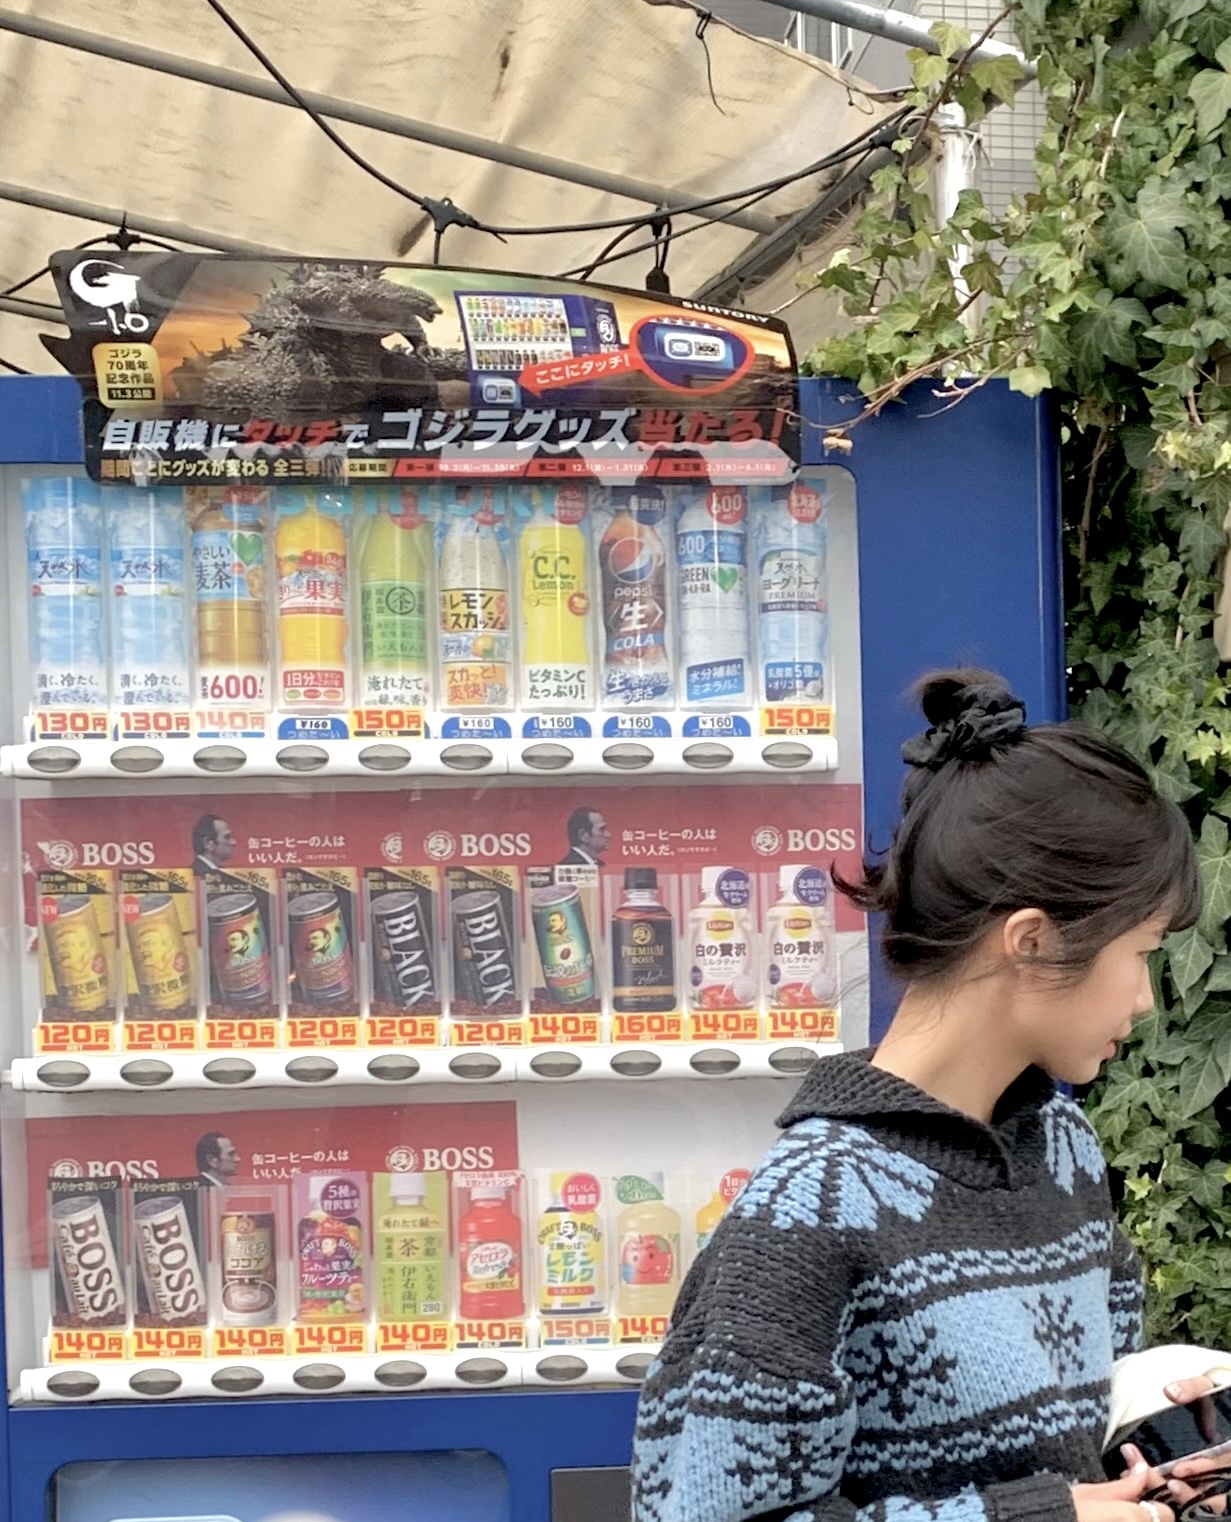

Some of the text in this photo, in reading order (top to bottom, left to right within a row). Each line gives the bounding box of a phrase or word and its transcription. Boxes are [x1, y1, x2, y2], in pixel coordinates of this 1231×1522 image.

[108, 348, 142, 360] ゴジラ
[107, 360, 149, 372] 70周年
[535, 353, 631, 386] ここにタッチ!
[106, 372, 155, 386] 記念作品
[192, 545, 231, 560] やさしい
[37, 559, 91, 580] 天然水
[120, 559, 173, 580] 天然水
[195, 563, 232, 591] 麦茶
[532, 555, 577, 580] C.C.
[531, 579, 575, 591] Lemon
[450, 592, 495, 610] レモン
[619, 600, 649, 633] 生
[613, 632, 656, 651] COLA
[528, 669, 587, 684] ビタミンC
[528, 684, 586, 700] たっぷり!
[37, 711, 107, 732] 130円
[120, 711, 190, 732] 130円
[195, 710, 266, 731] 140円
[300, 720, 329, 730] ¥160
[352, 710, 422, 729] 150円
[462, 717, 492, 728] ¥160
[541, 716, 574, 729] ¥160
[620, 716, 652, 729] ¥160
[700, 716, 732, 729] ¥160
[764, 708, 831, 728] 150円
[247, 835, 346, 849] 缶コーヒーの人は
[460, 832, 532, 857] BOSS
[621, 828, 717, 842] 缶コーヒーの人は
[786, 828, 856, 852] BOSS
[81, 841, 156, 866] BOSS
[707, 921, 732, 930] Lipton
[785, 919, 810, 928] Lipton
[621, 945, 664, 957] PREMIUM
[695, 942, 747, 957] 白の贅沢
[773, 940, 825, 956] 白の贅沢
[383, 911, 434, 1010] BLACK
[464, 910, 515, 1009] BLACK
[288, 1019, 357, 1039] 120円
[366, 1018, 435, 1038] 120円
[529, 1015, 597, 1035] 140円
[615, 1014, 682, 1033] 160円
[691, 1013, 759, 1032] 140円
[768, 1011, 836, 1031] 140円
[40, 1024, 110, 1044] 120円
[124, 1022, 194, 1043] 120円
[205, 1021, 275, 1041] 120円
[453, 1023, 522, 1042] 120円
[252, 1149, 349, 1166] 缶コーヒーの人は
[422, 1146, 495, 1170] BOSS
[86, 1160, 160, 1179] BOSS
[566, 1183, 597, 1193] おいしく
[399, 1238, 420, 1258] 茶
[70, 1214, 118, 1313] BOSS
[152, 1214, 200, 1313] BOSS
[230, 1257, 264, 1270] ココア
[546, 1251, 595, 1268] レモン
[301, 1271, 359, 1286] フルーツティー
[546, 1268, 594, 1284] ミルク
[400, 1265, 418, 1315] 伊右衛門
[294, 1326, 363, 1345] 140円
[379, 1324, 447, 1343] 140円
[455, 1322, 523, 1341] 140円
[544, 1319, 611, 1337] 150円
[53, 1332, 123, 1351] 140円
[133, 1330, 203, 1349] 140円
[214, 1328, 285, 1348] 140円
